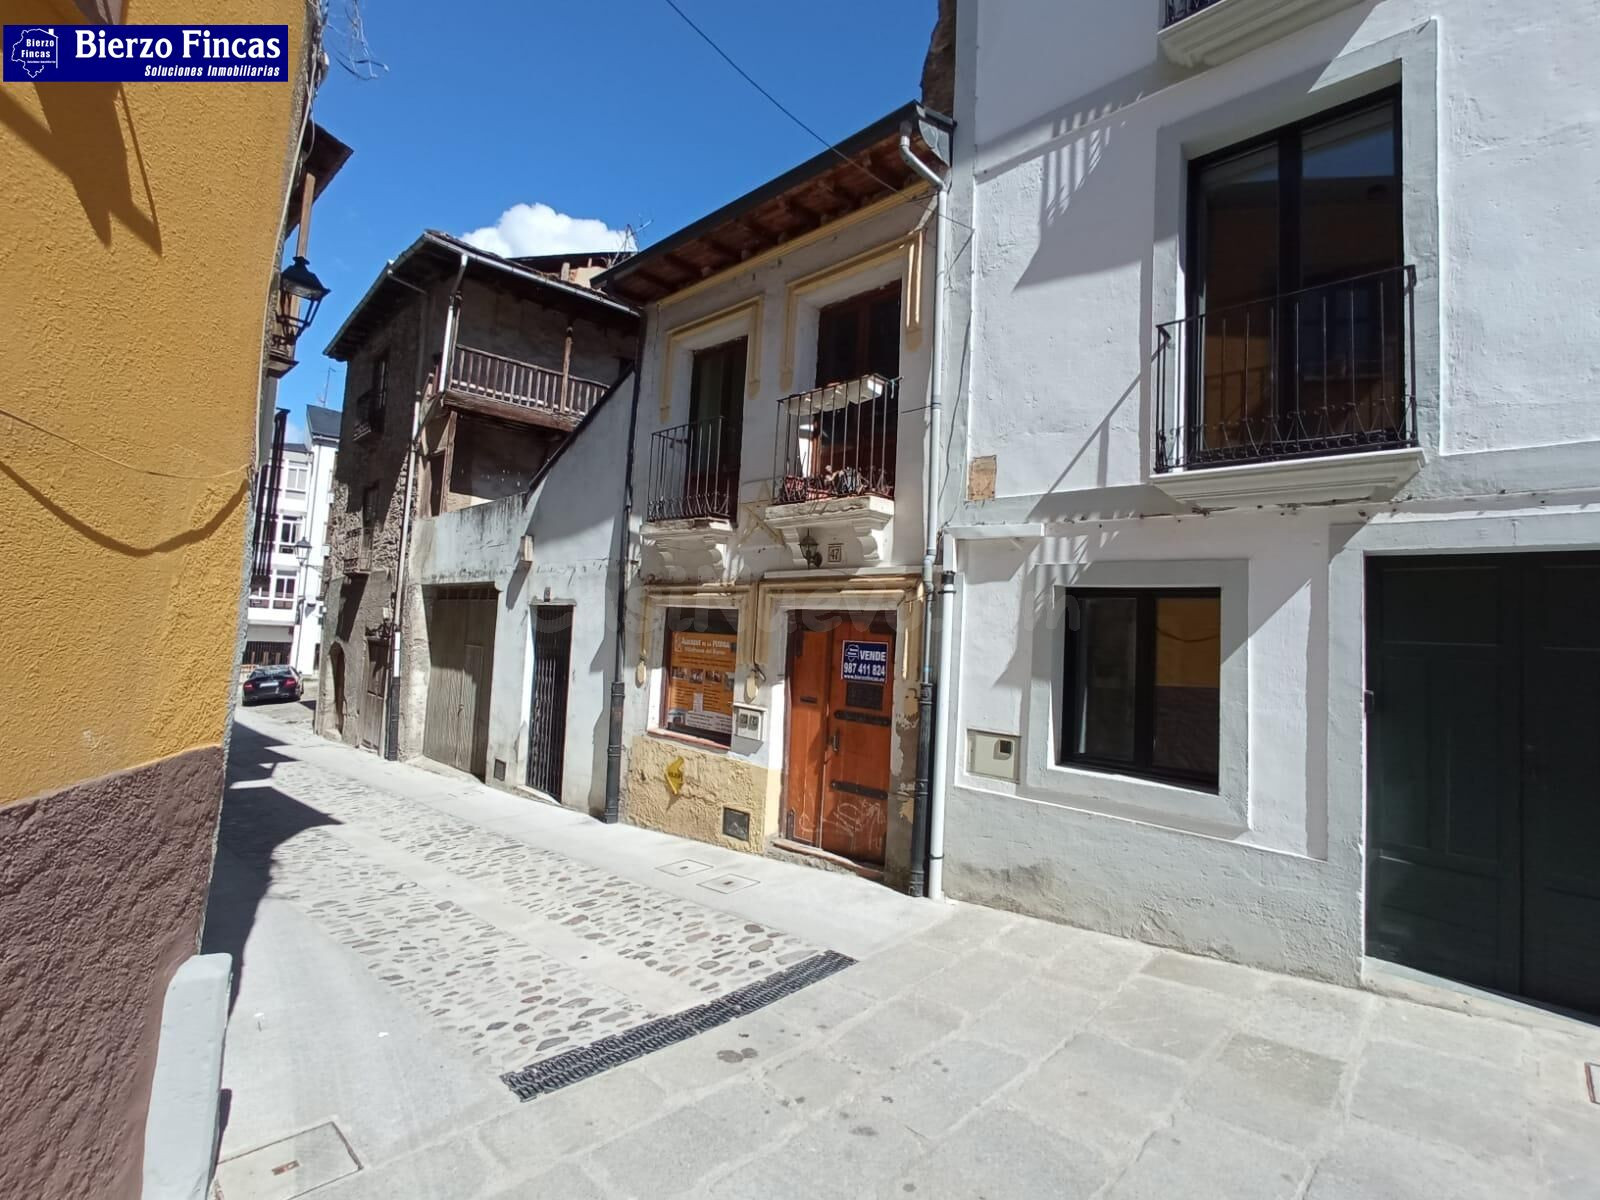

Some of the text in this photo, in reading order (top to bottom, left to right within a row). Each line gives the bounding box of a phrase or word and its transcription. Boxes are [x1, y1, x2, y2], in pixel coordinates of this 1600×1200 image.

[860, 650, 886, 661] VENDE
[843, 662, 885, 676] 987 411 824
